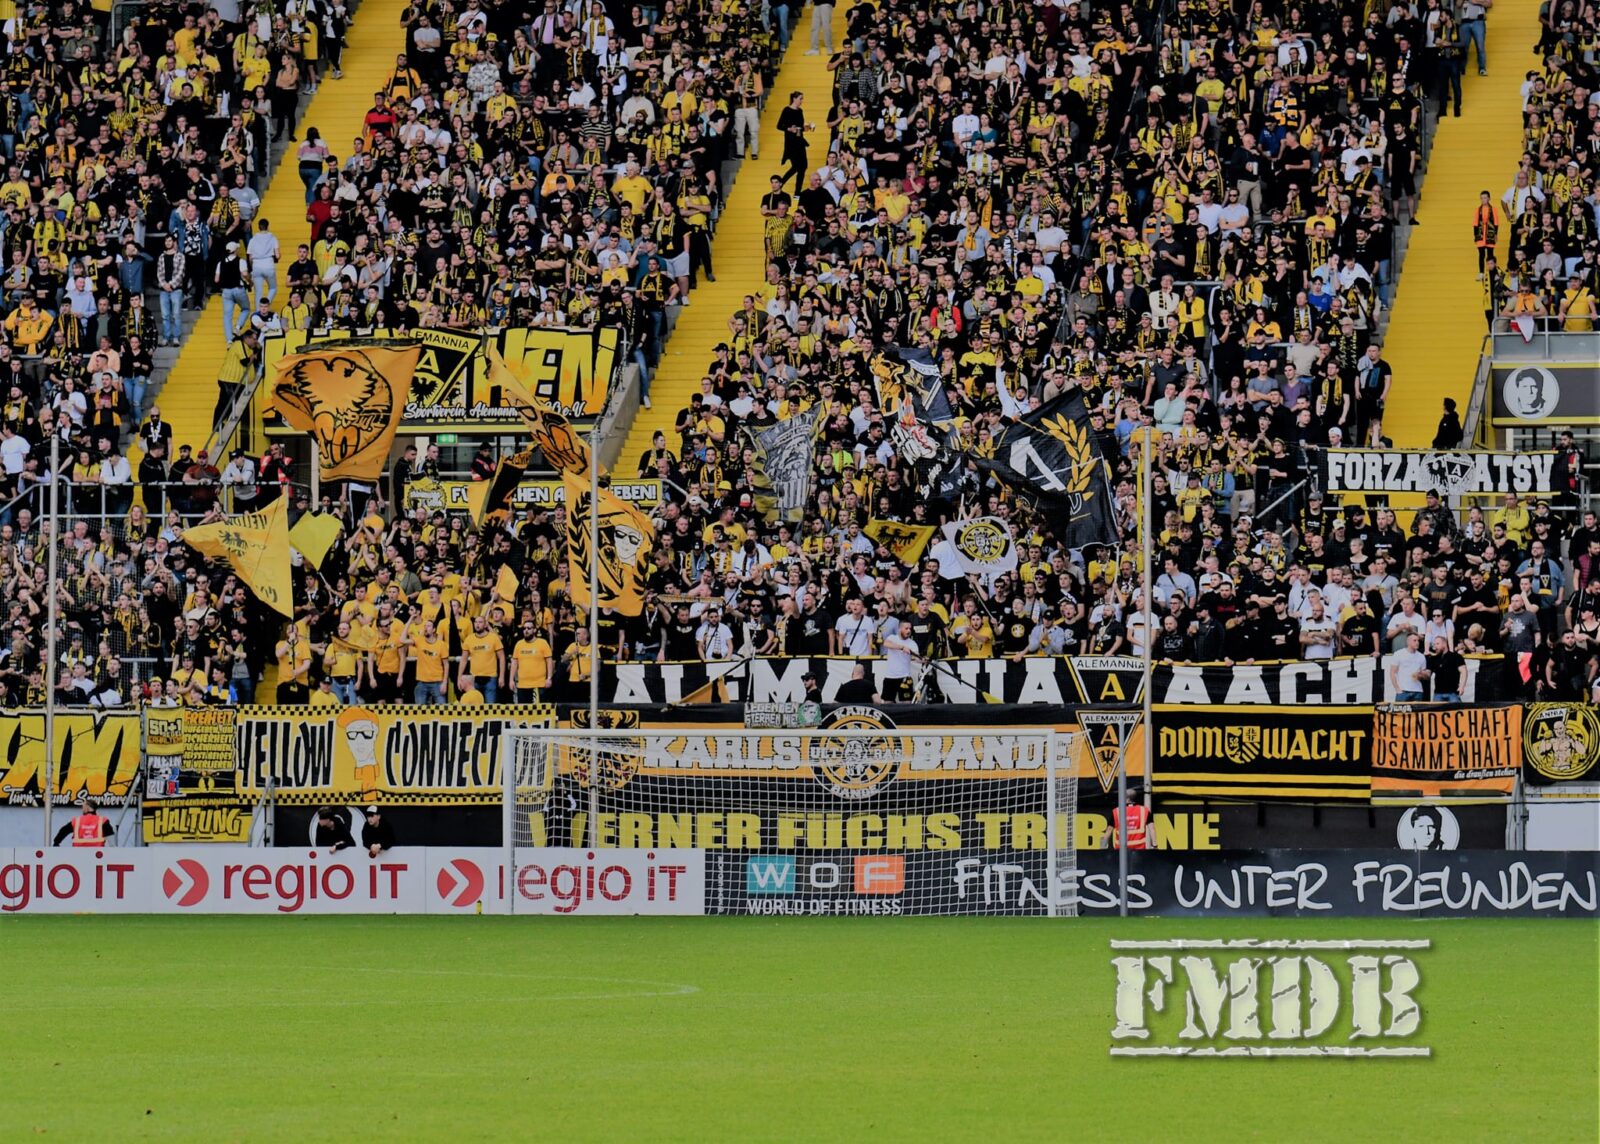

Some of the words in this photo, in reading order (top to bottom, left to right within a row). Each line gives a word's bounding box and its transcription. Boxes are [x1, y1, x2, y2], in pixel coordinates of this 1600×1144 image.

[415, 331, 470, 350] EMANNIA
[469, 402, 520, 418] Alemann
[1327, 453, 1423, 491] FORZA
[1472, 453, 1555, 492] ATSV
[1100, 672, 1126, 700] A
[184, 710, 233, 725] FREIHEIT
[1376, 708, 1511, 741] REUNDSCHAFT
[1100, 725, 1119, 745] A
[1158, 725, 1226, 760] DOM
[1261, 729, 1367, 762] WACHT
[238, 720, 335, 788] YELLOW
[385, 719, 549, 788] CONNECTON
[642, 735, 801, 770] KARLS
[1375, 737, 1512, 770] USAMMENHALT
[153, 806, 243, 836] HALTUNG
[975, 812, 1221, 850] TRIBNE
[0, 849, 81, 912] gio
[223, 849, 355, 913] regio
[953, 858, 1154, 909] FITNESS
[1173, 861, 1333, 911] UNTER
[1351, 860, 1598, 912] FREUNDEN
[749, 899, 805, 915] WORLD
[809, 899, 831, 915] OF
[834, 899, 902, 915] FITNESS
